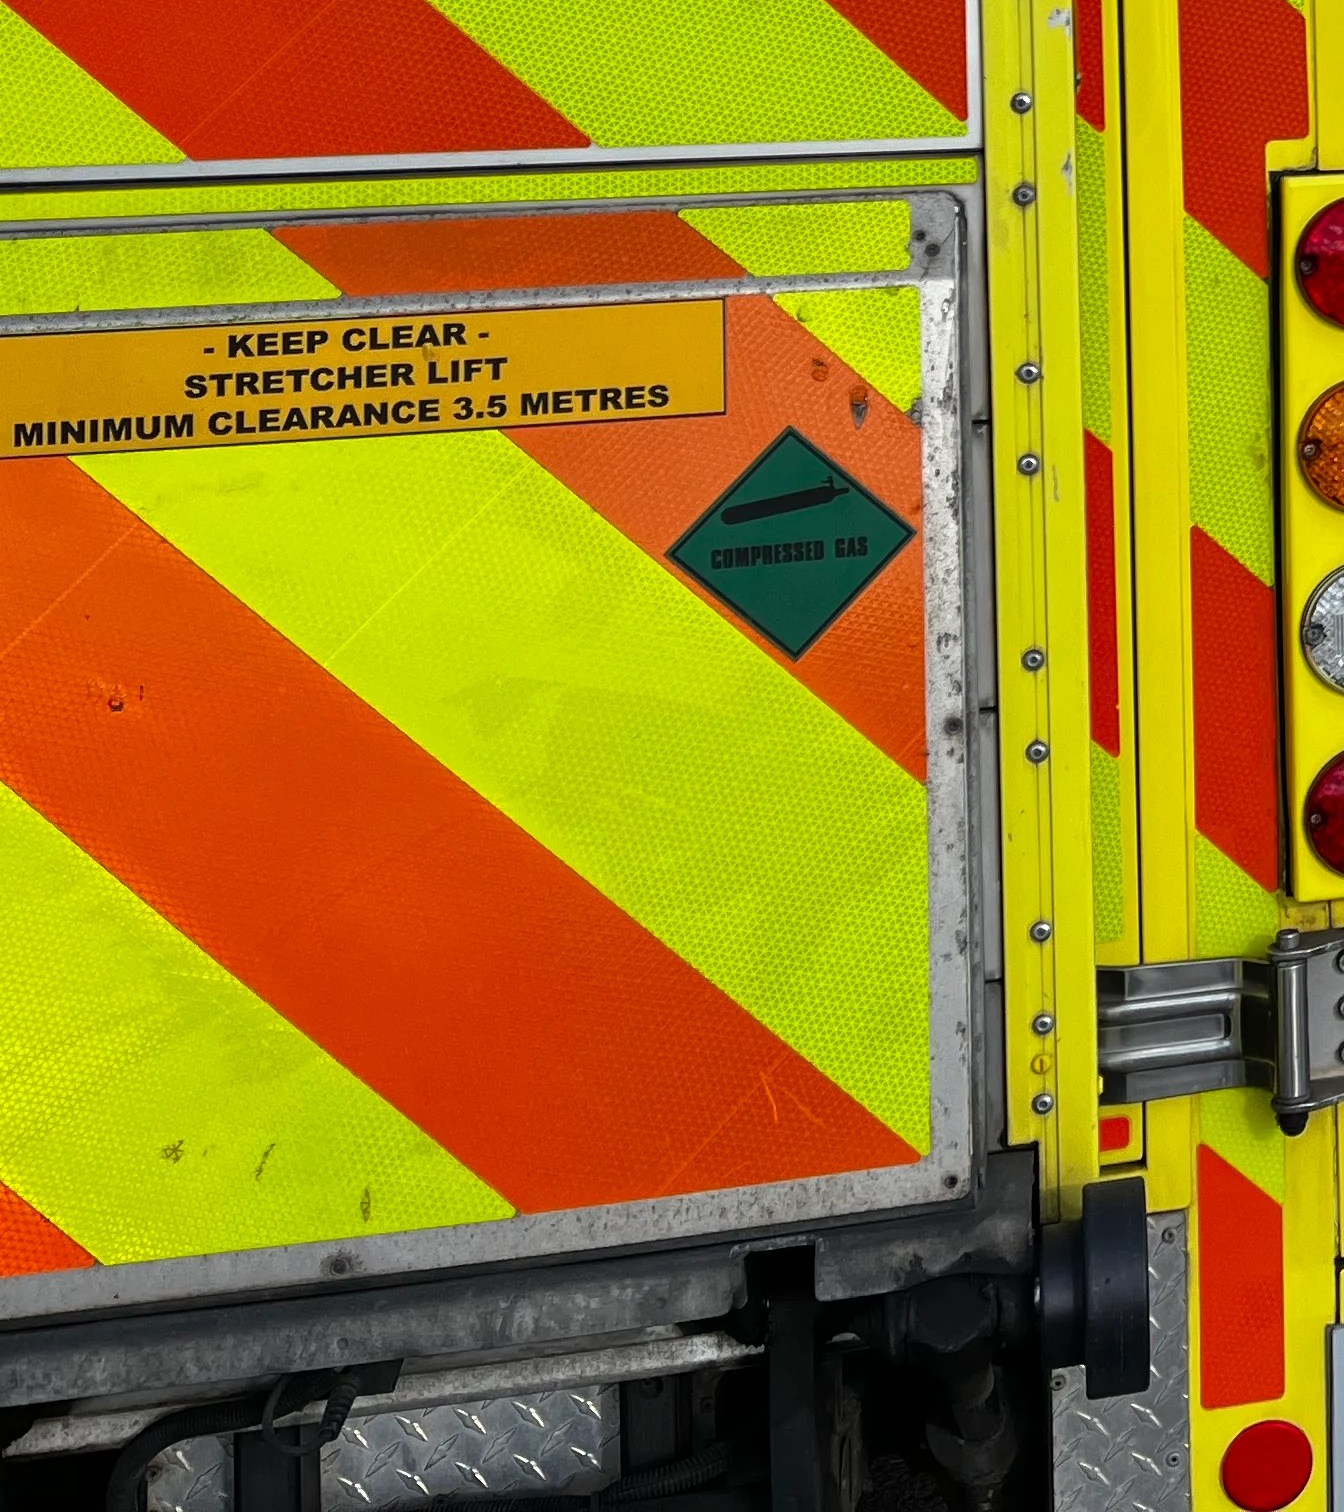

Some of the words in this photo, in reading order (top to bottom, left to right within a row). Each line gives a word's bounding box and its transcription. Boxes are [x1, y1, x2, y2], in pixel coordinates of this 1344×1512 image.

[228, 330, 329, 359] KEEP
[341, 323, 467, 352] CLEAR
[184, 363, 415, 399] STRETCHER
[428, 357, 508, 385] LIFT
[13, 414, 195, 448] MINIMUM
[208, 399, 440, 436] CLEARANCE
[452, 394, 508, 420] 3.5
[520, 384, 670, 417] METRES
[710, 540, 825, 570] COMPRESSED
[834, 536, 869, 559] GAS
